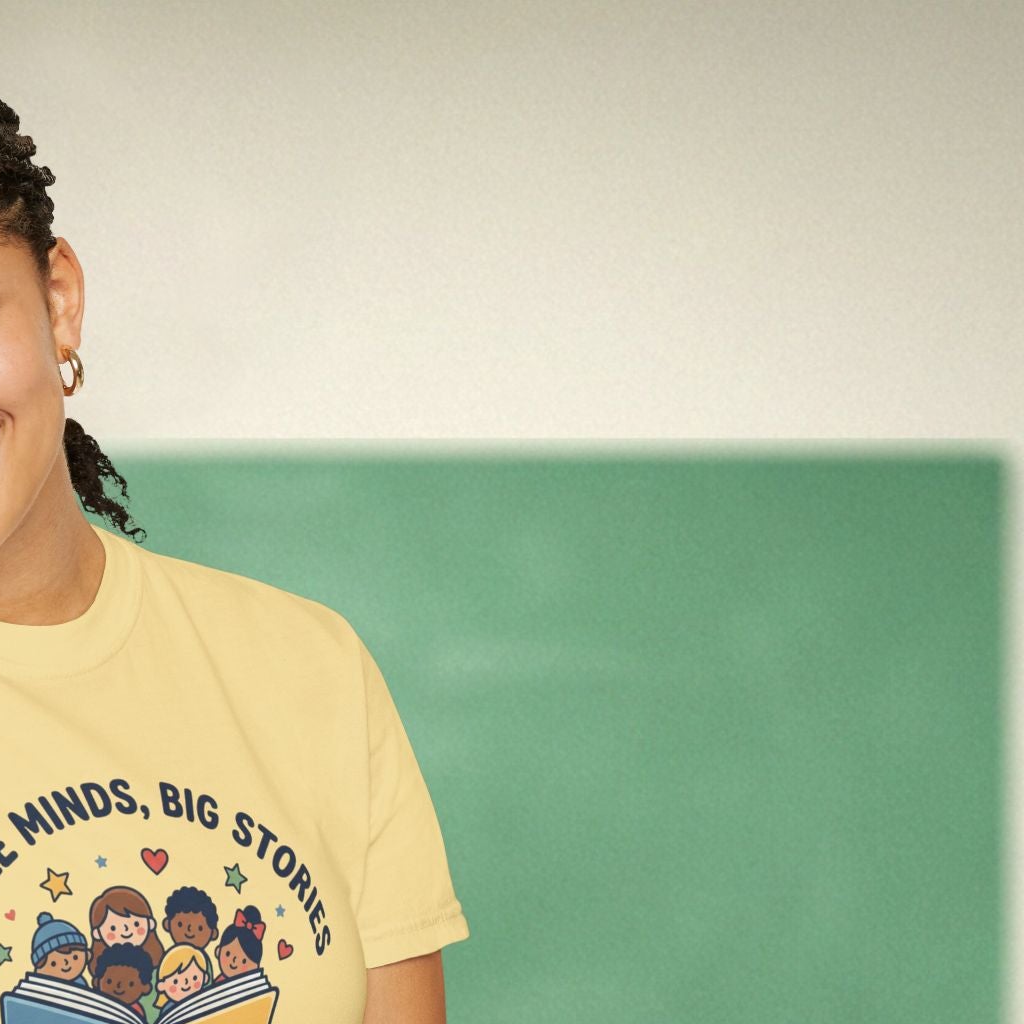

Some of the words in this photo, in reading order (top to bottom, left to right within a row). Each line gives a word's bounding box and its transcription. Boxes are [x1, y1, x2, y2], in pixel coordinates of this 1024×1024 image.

[7, 778, 151, 846] MINDS,
[158, 781, 219, 830] BIG
[231, 811, 331, 956] STORIES
